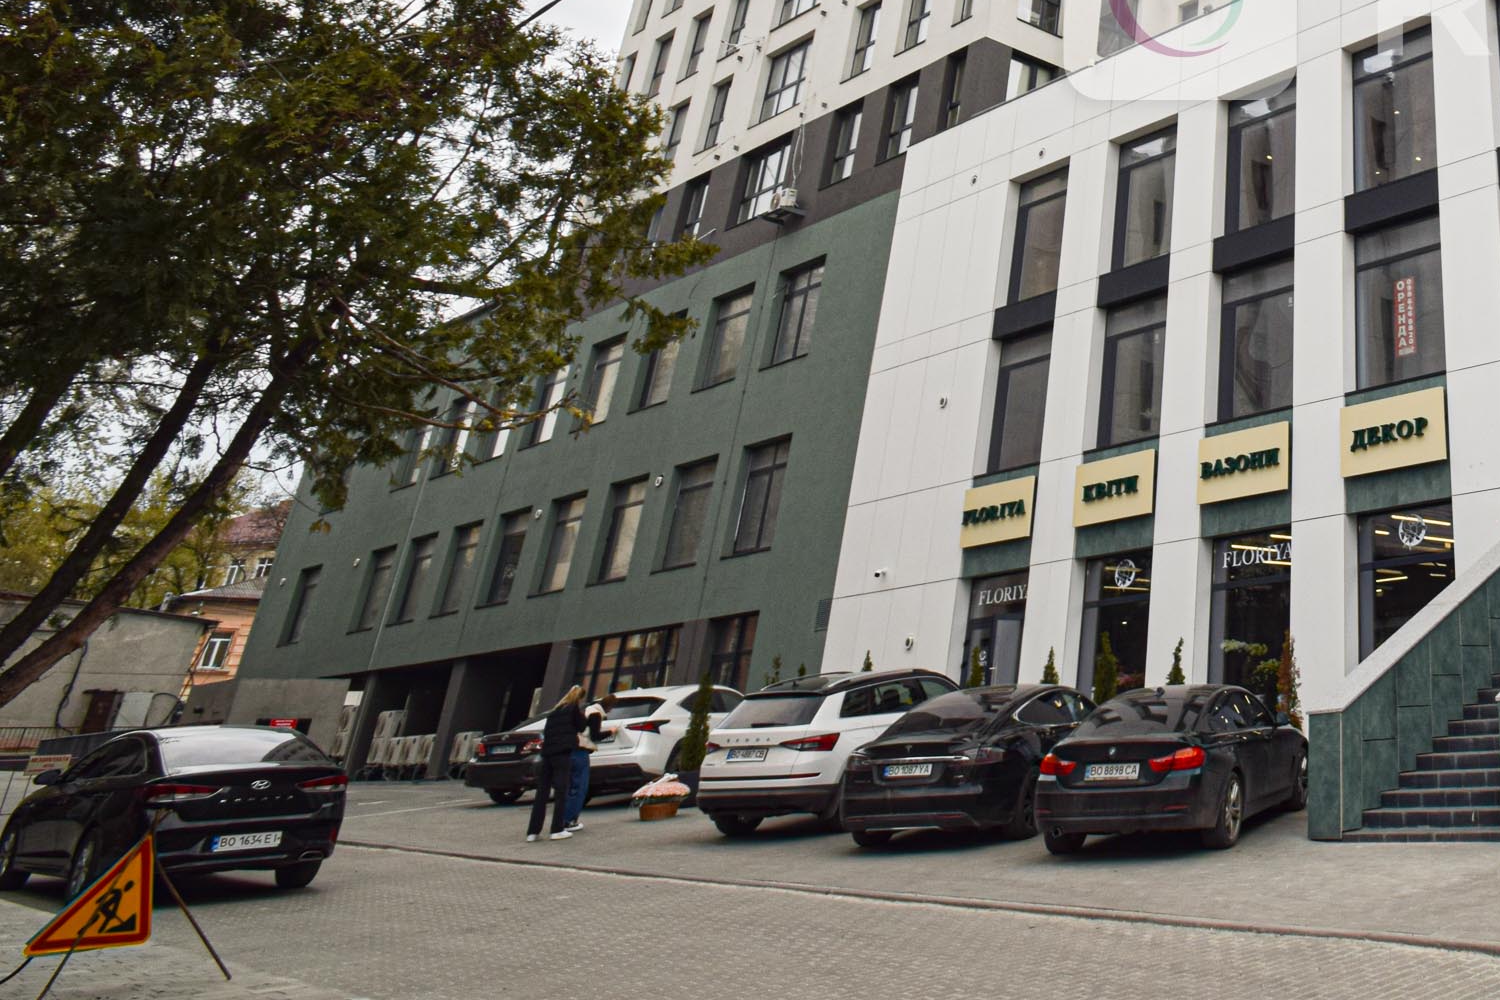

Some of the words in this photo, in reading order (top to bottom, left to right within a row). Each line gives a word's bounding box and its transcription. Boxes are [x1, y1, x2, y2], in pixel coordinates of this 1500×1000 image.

[1350, 417, 1428, 452] ДЕКОР
[1200, 448, 1280, 480] ВАЗОНИ
[1082, 475, 1139, 502] КВІТИ
[962, 499, 1026, 526] FLORIYA
[1222, 542, 1292, 568] FLORIYA
[1125, 765, 1137, 775] CA
[220, 837, 236, 847] BO
[240, 835, 262, 846] 1634
